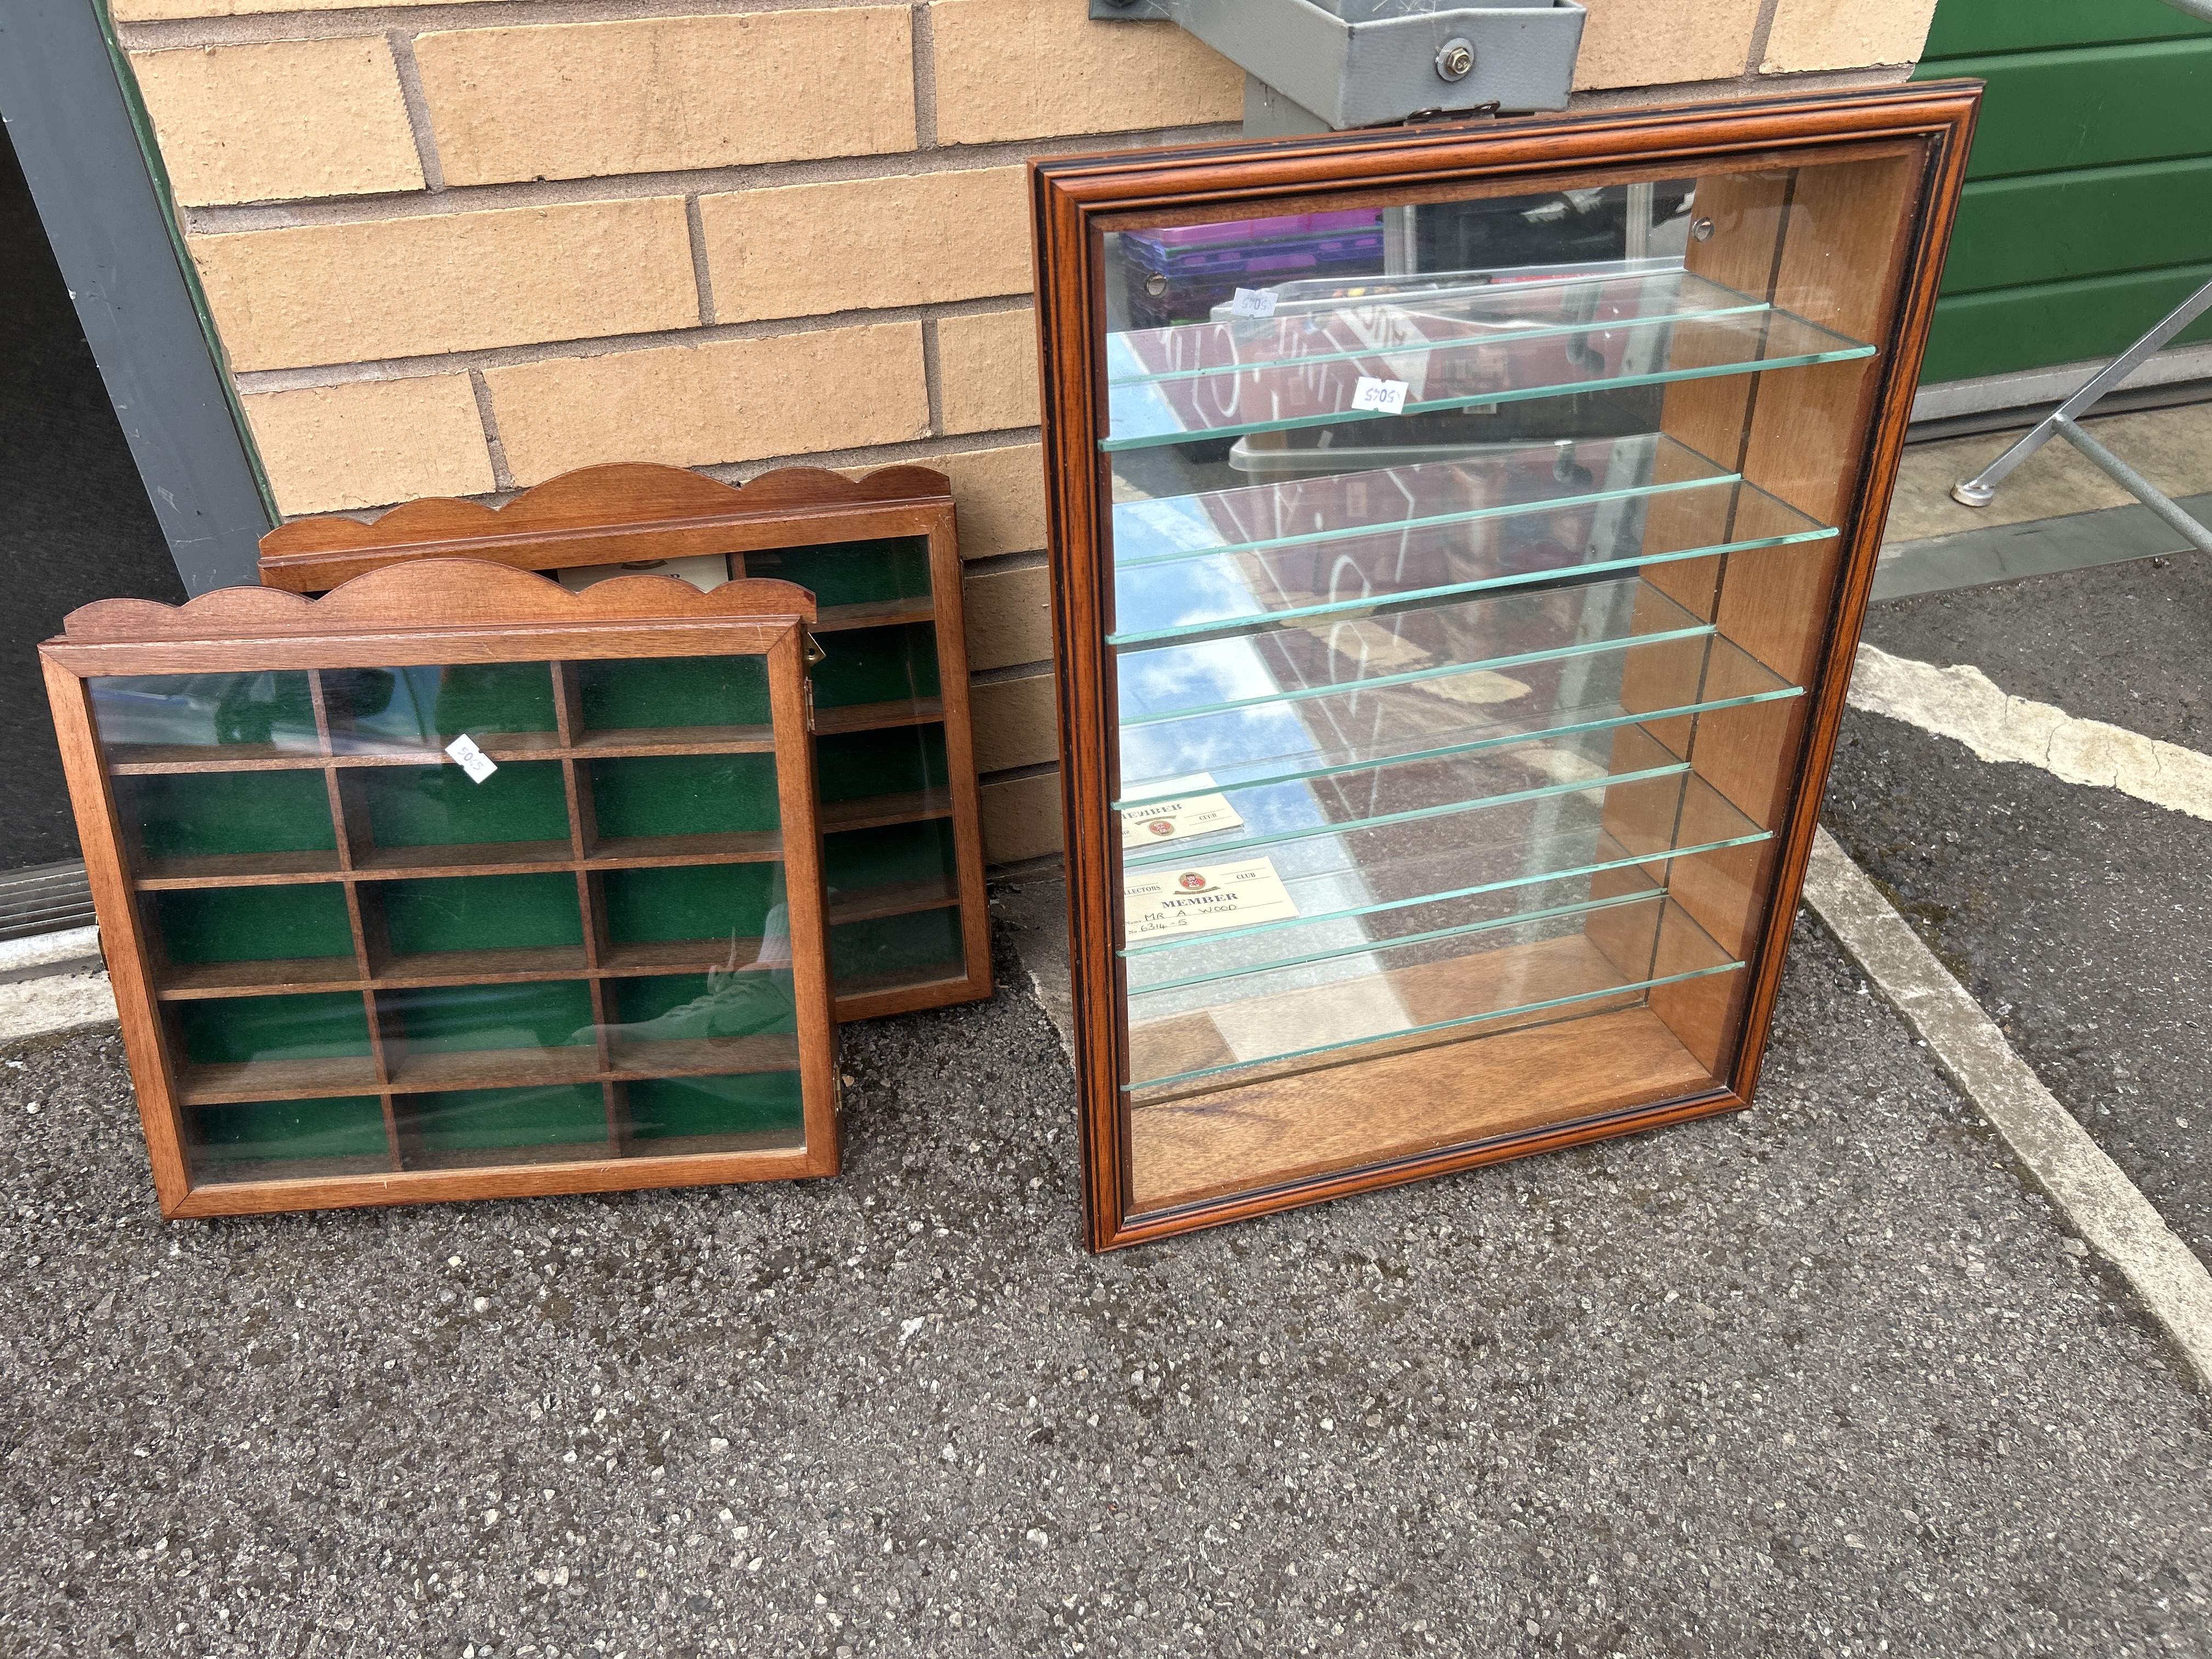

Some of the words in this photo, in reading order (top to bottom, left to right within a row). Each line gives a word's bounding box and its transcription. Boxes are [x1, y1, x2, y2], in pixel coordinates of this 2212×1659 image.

[457, 746, 484, 770] 5045
[1161, 893, 1239, 909] MEMBER
[1144, 912, 1164, 922] MR
[1198, 904, 1237, 913] WOOD
